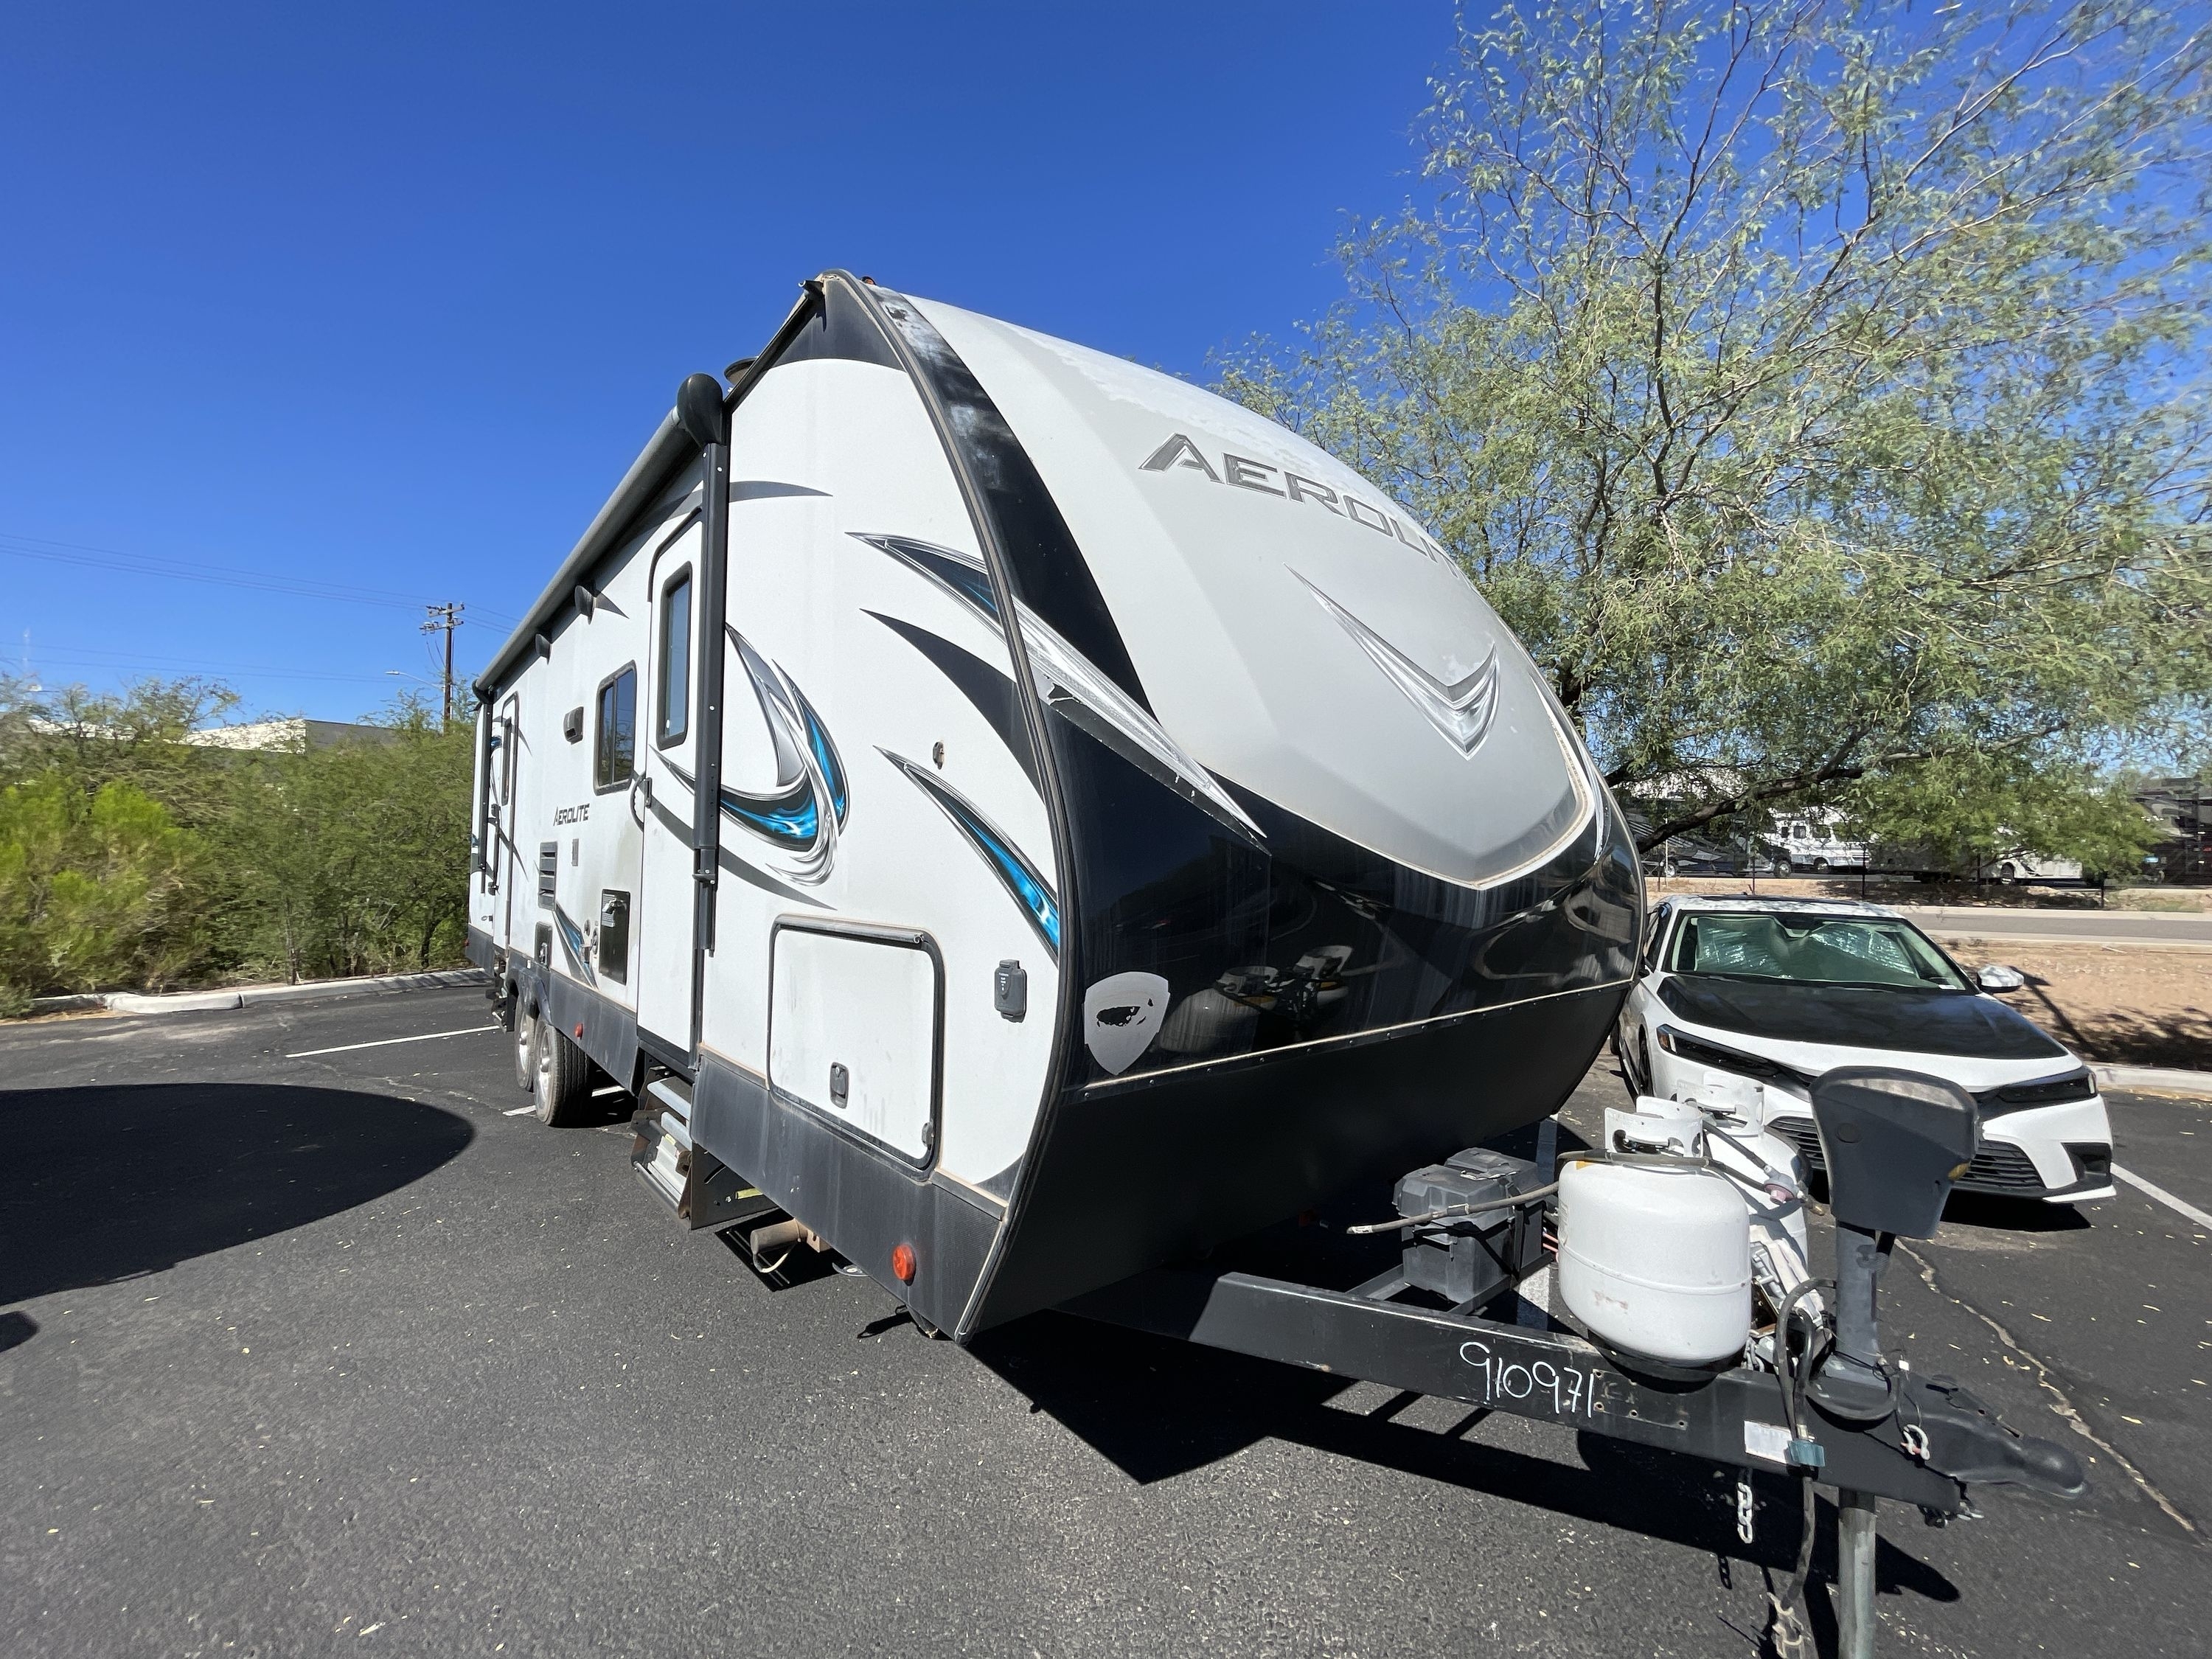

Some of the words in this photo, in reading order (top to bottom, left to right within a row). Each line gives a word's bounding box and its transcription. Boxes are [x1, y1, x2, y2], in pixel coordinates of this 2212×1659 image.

[1139, 433, 1464, 580] AEROLIT
[553, 803, 590, 826] AEROLITE
[1458, 1340, 1594, 1418] 910971
